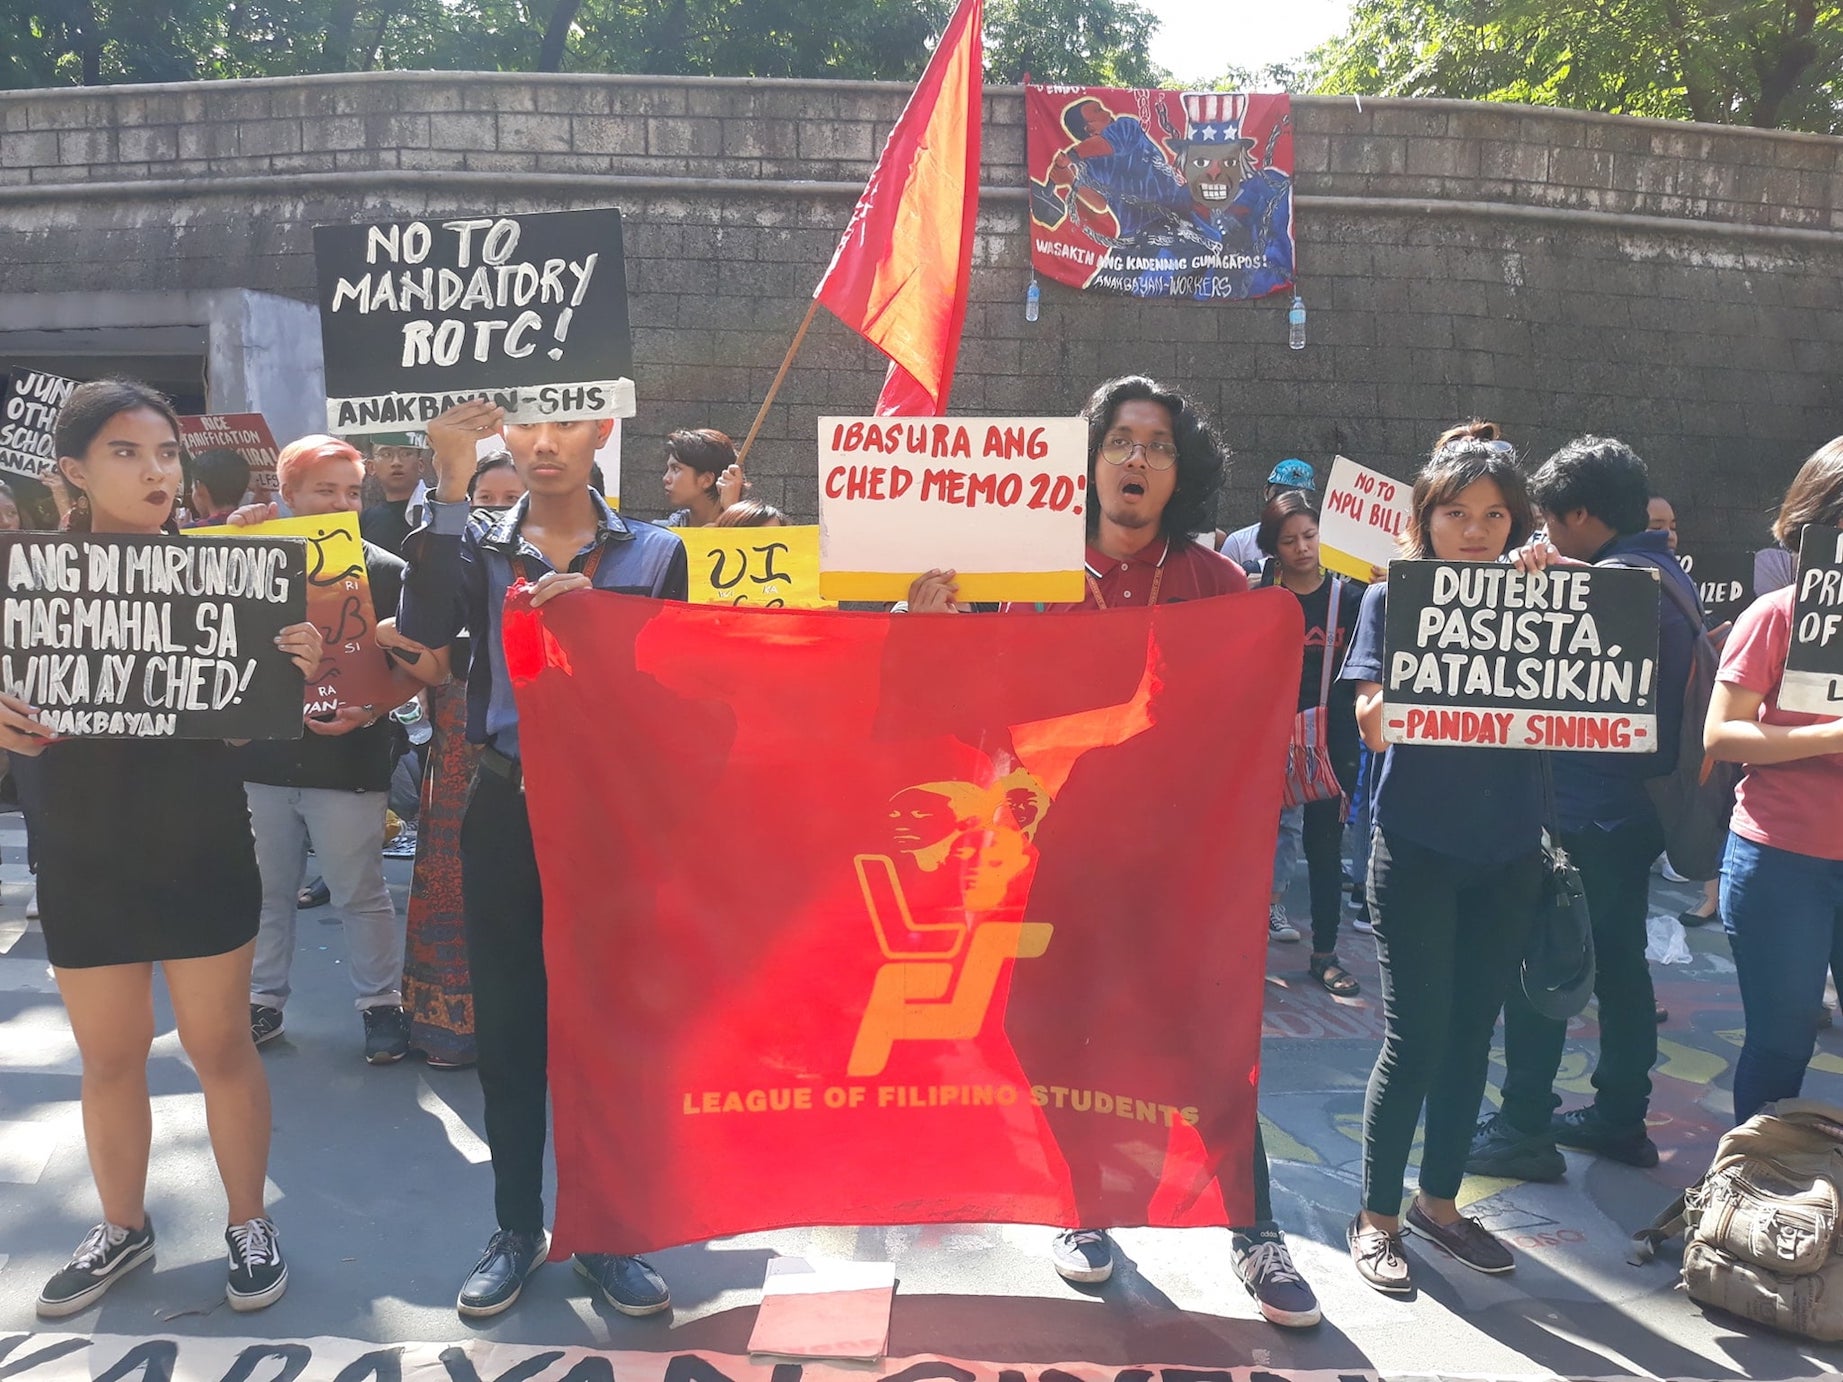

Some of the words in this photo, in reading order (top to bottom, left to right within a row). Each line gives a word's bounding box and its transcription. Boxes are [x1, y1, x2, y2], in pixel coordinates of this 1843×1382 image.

[367, 222, 431, 264] NO
[442, 218, 521, 267] TO
[1036, 239, 1094, 265] WASAKIN
[332, 253, 599, 314] MANDATORY
[402, 307, 573, 368] ROTC!
[7, 397, 61, 434] OTH
[200, 416, 231, 431] RICE
[0, 423, 57, 460] SCHO
[831, 421, 971, 459] IBASURA
[983, 425, 1049, 460] ANG
[825, 465, 913, 501] CHED
[920, 468, 1023, 508] MEMO
[1328, 488, 1364, 522] NPU
[1354, 472, 1375, 494] NO
[1377, 481, 1395, 502] TO
[8, 543, 80, 593] ANG
[126, 545, 289, 603] MARUNONG
[345, 580, 359, 591] RI
[1433, 566, 1591, 612] DUTERTE
[1694, 581, 1743, 603] IZED
[4, 598, 187, 653] MAGMAHAL
[195, 602, 238, 658] SA
[344, 642, 360, 653] SI
[2, 654, 90, 705] WIKA
[94, 654, 136, 705] AY
[143, 655, 257, 711] CHED!
[318, 684, 337, 697] RA
[1390, 652, 1653, 707] PATALSIKIN!
[683, 1088, 813, 1115] LEAGUE
[824, 1086, 865, 1109] OF
[878, 1083, 1017, 1109] FILIPINO
[1030, 1084, 1200, 1128] STUDENTS
